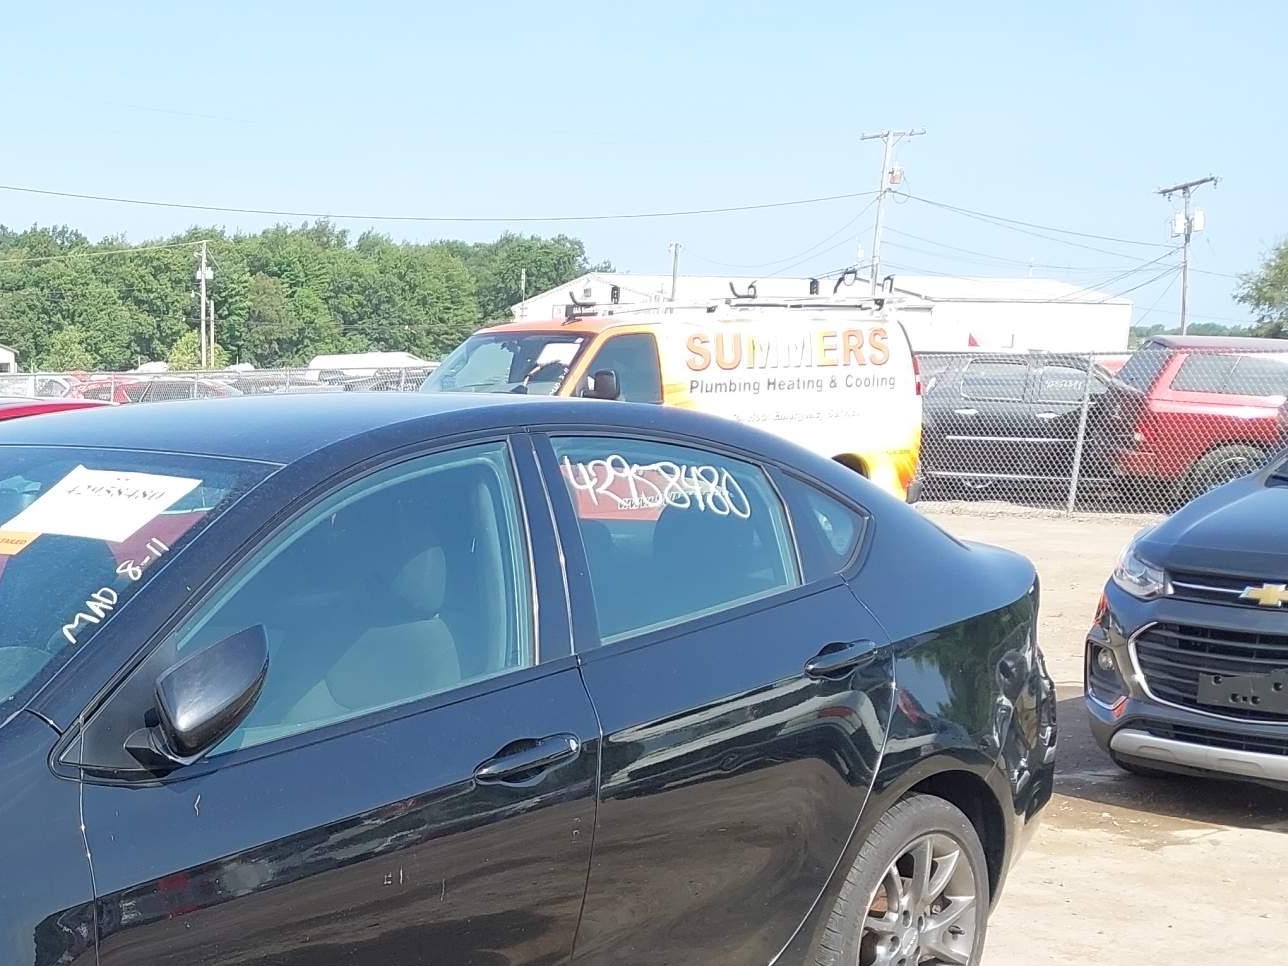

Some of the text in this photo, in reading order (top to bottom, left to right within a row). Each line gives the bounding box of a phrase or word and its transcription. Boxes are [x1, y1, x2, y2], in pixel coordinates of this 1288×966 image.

[685, 327, 890, 372] SUMMERS
[689, 374, 896, 395] Plumbing Heating & Cooling
[562, 454, 752, 519] 42958480
[62, 537, 170, 645] MAD 8-11
